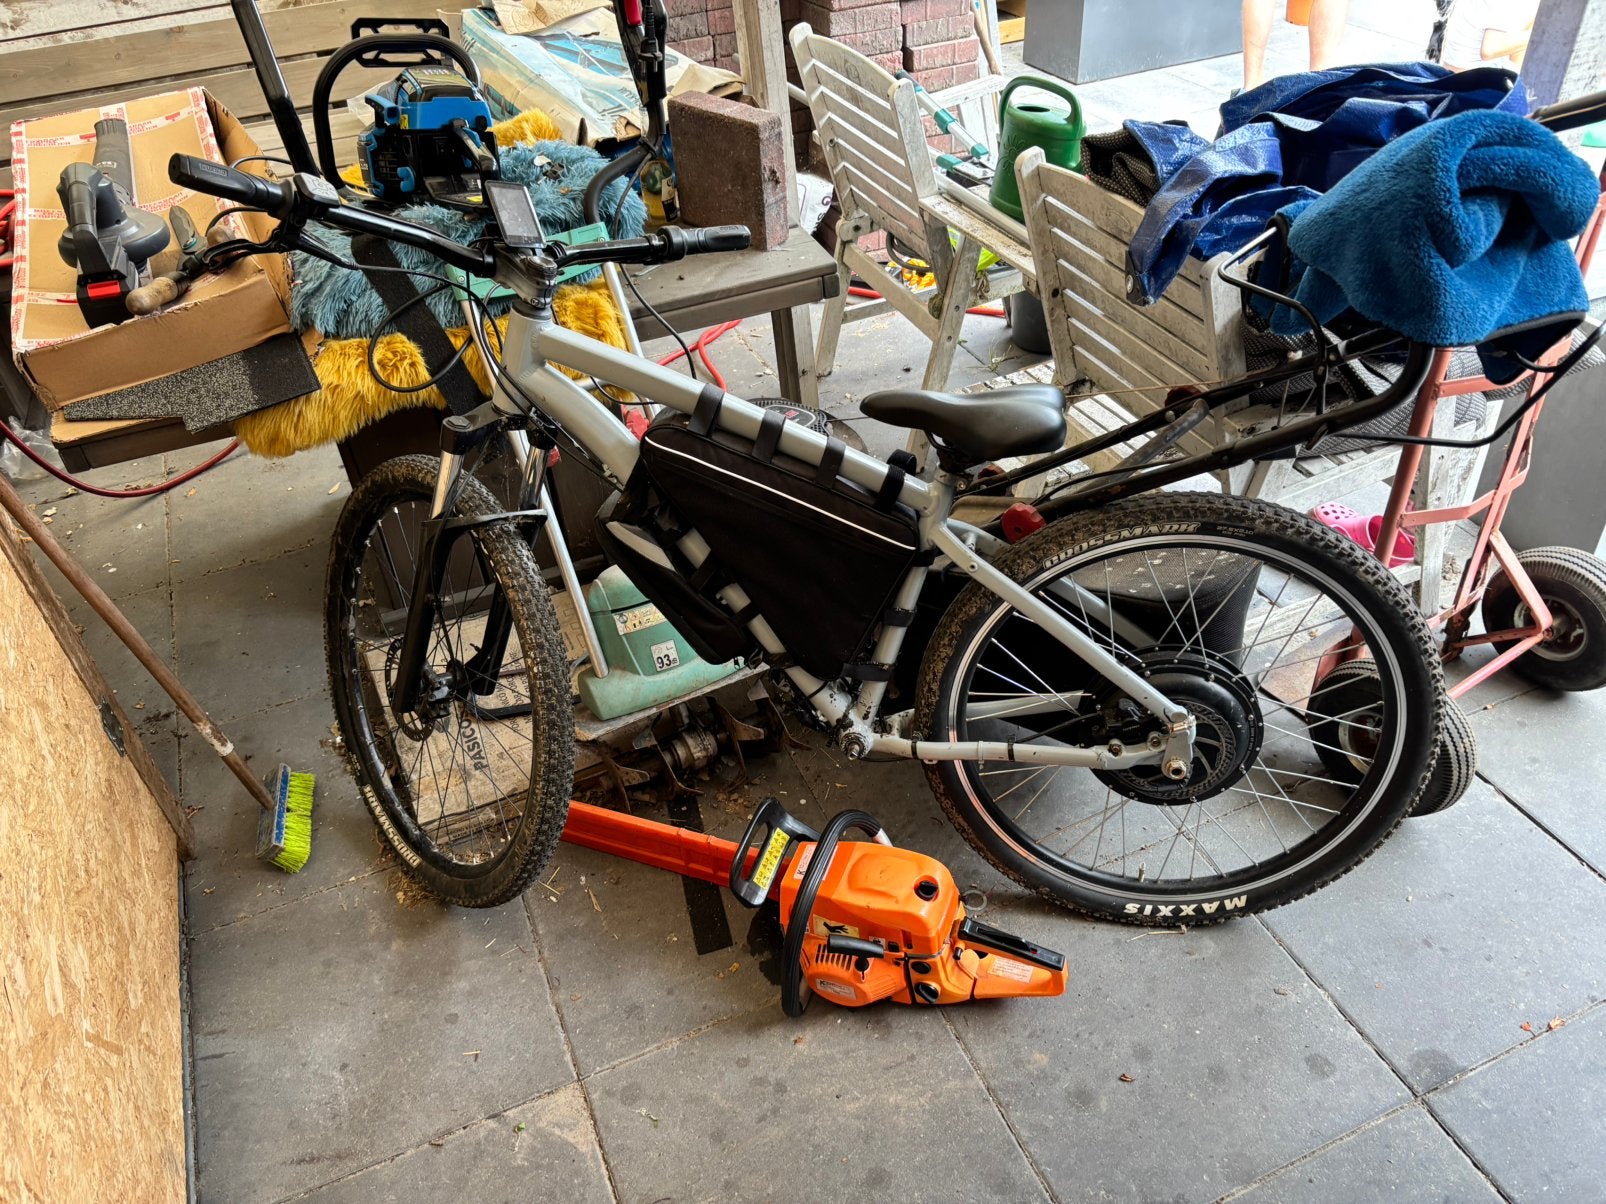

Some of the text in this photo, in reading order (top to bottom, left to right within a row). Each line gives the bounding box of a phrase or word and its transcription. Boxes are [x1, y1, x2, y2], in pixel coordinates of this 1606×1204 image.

[1042, 521, 1202, 570] CROSSMARK
[656, 653, 671, 669] 93
[459, 718, 490, 771] PASICO
[362, 783, 423, 869] CROSSMARK
[1123, 894, 1248, 917] MAXXIS
